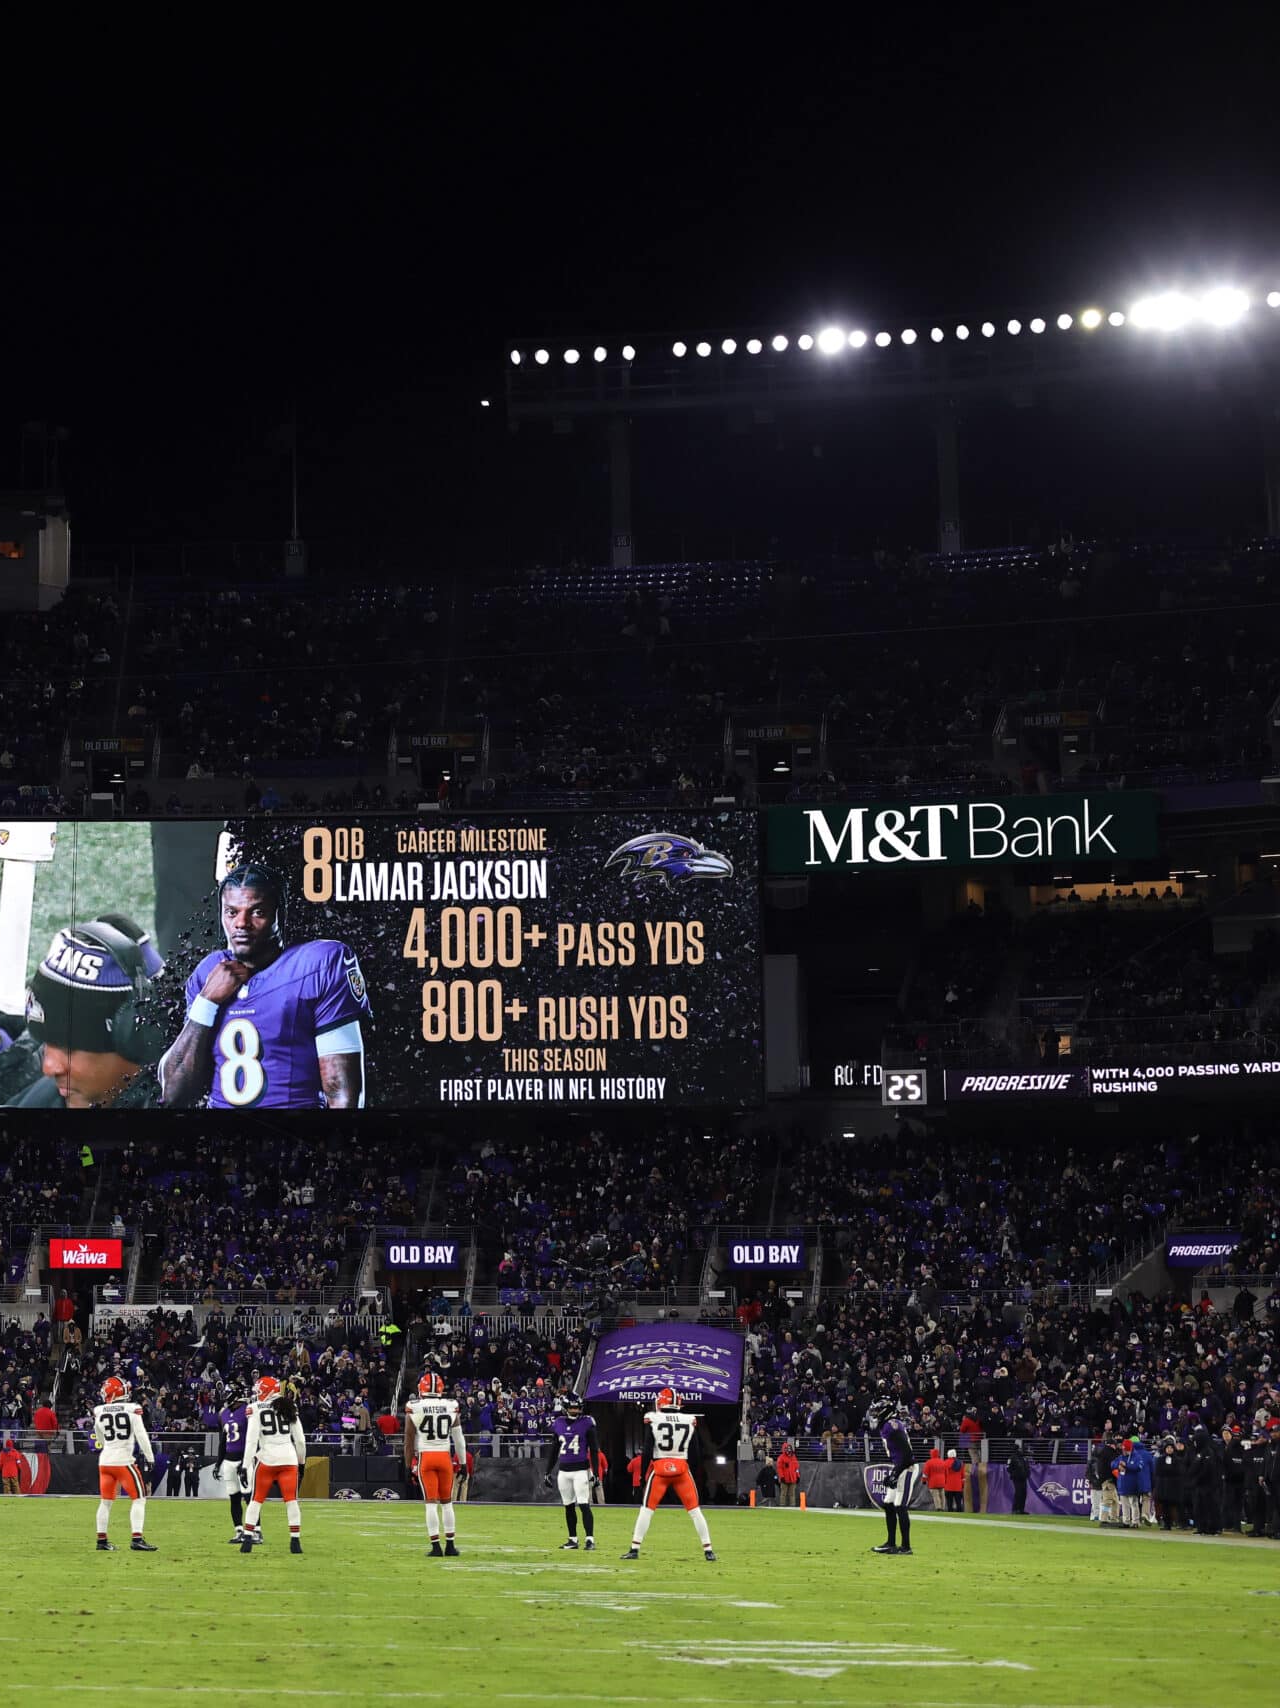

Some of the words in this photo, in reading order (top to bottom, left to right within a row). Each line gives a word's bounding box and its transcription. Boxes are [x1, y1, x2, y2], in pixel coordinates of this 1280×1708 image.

[334, 827, 364, 862] QB
[397, 829, 457, 854] CAREER
[460, 828, 547, 853] MILESTONE
[803, 803, 959, 866] M&T
[968, 798, 1117, 860] Bank
[302, 827, 333, 902] 8
[334, 861, 423, 902] LAMAR
[430, 859, 548, 900] JACKSON
[403, 906, 548, 976] 4,000+
[557, 922, 635, 967] PASS
[645, 920, 705, 966] YDS
[421, 979, 528, 1043] 800+
[538, 997, 616, 1040] RUSH
[628, 995, 688, 1039] YDS
[219, 1017, 265, 1106] 8
[502, 1048, 539, 1073] THIS
[543, 1047, 607, 1072] SEASON
[1091, 1066, 1129, 1080] WITH
[1133, 1065, 1174, 1081] 4,000
[1178, 1062, 1240, 1077] PASSING
[439, 1079, 483, 1101] FIRST
[487, 1079, 544, 1101] PLAYER
[549, 1079, 563, 1100] IN
[568, 1078, 596, 1100] NFL
[600, 1077, 666, 1100] HISTORY
[888, 1074, 921, 1101] 25
[961, 1075, 1071, 1092] PROGRESSIVE
[1092, 1081, 1158, 1094] RUSHING
[63, 1249, 108, 1265] Wawa
[390, 1246, 420, 1264] OLD
[424, 1246, 455, 1264] BAY
[733, 1246, 764, 1264] OLD
[768, 1246, 800, 1264] BAY
[605, 1341, 732, 1356] MEDSTAR
[616, 1347, 719, 1360] HEALTH
[598, 1374, 729, 1390] MEDSTAR
[609, 1380, 716, 1393] HEALTH
[619, 1391, 658, 1400] MEDSTA
[99, 1412, 131, 1441] 39
[419, 1415, 453, 1442] 40
[656, 1423, 689, 1452] 37
[558, 1434, 581, 1456] 24
